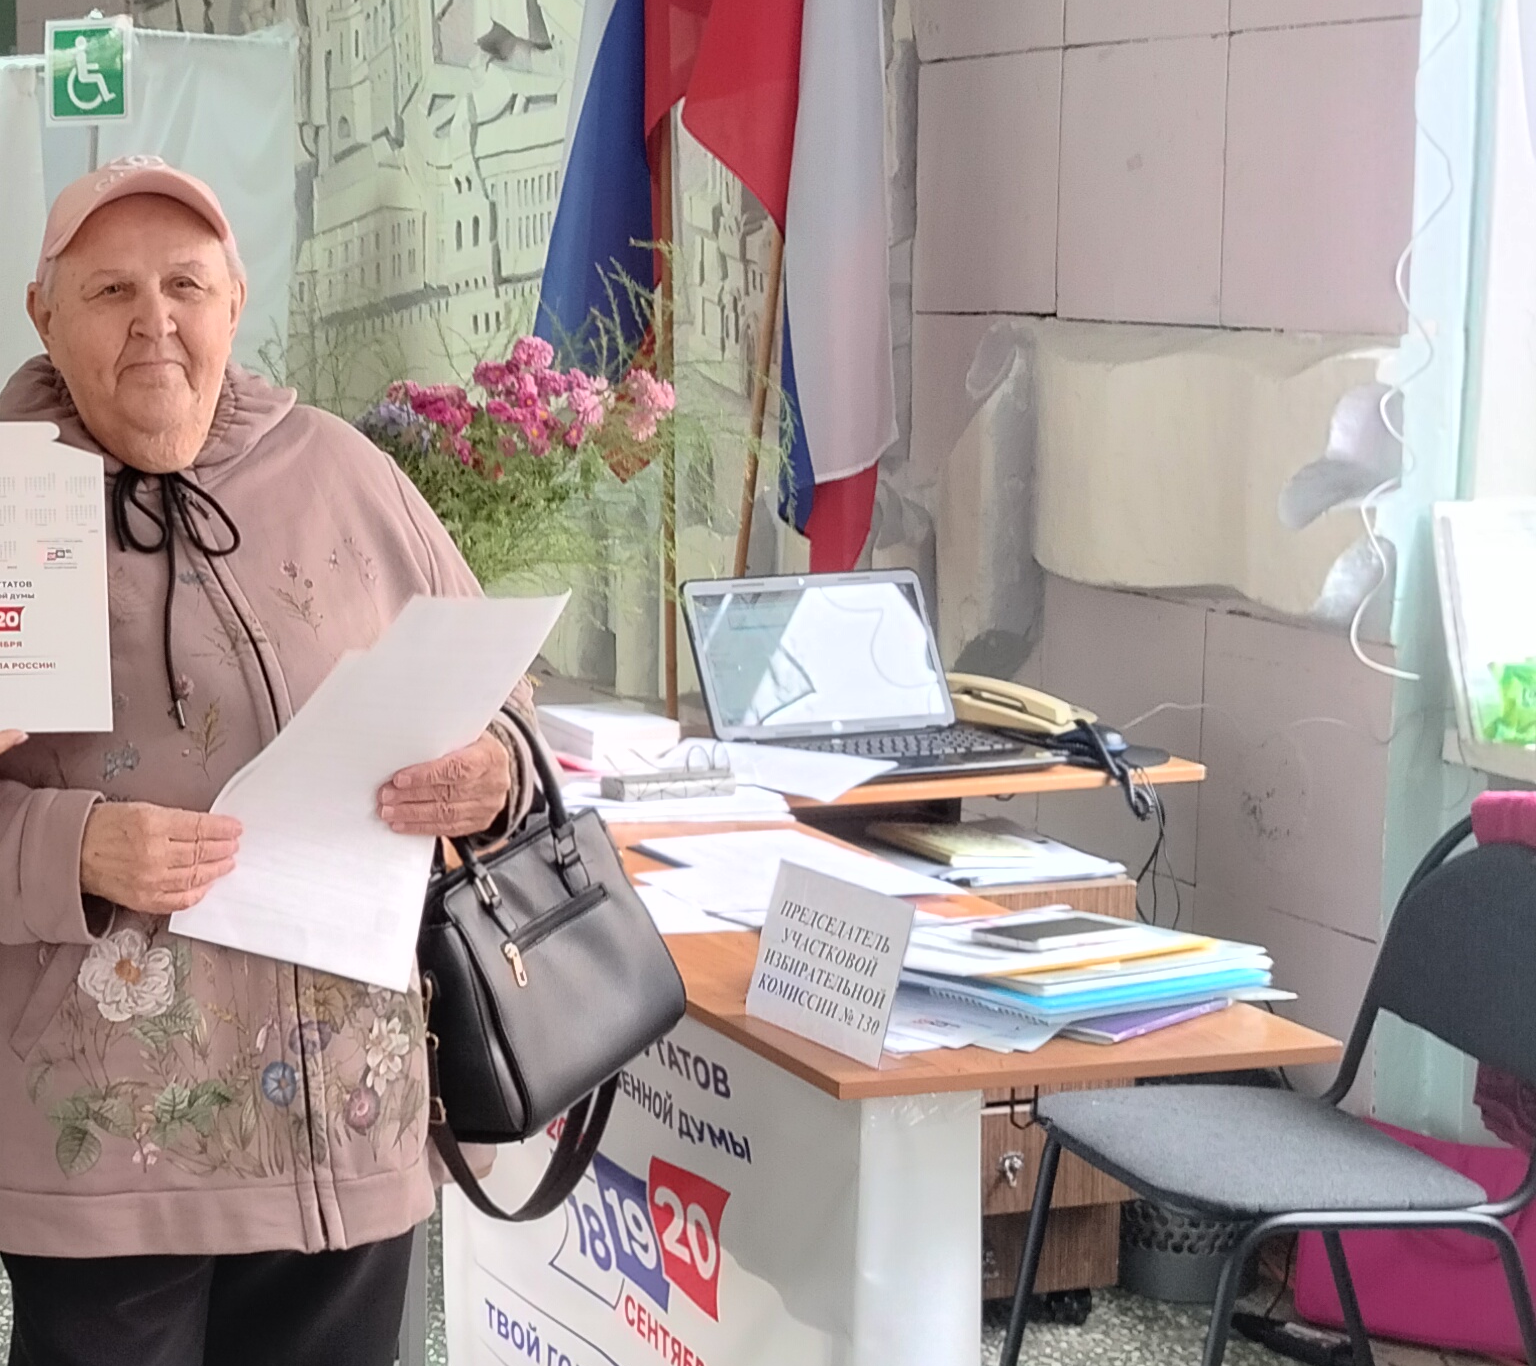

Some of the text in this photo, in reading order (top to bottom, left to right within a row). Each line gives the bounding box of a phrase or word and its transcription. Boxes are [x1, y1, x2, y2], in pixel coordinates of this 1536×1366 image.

[12, 662, 56, 670] РОССИИ!
[780, 900, 890, 954] ПРЕДСЕДАТЕЛЬ
[781, 927, 878, 978] УЧАСТКОВОЙ
[758, 973, 880, 1035] КОМИССИИ № 130
[764, 948, 886, 1010] ИЗБИРАТЕЛЬНОЙ
[645, 1035, 731, 1099] ТАТОВ
[617, 1068, 752, 1164] ЕННОЙ ДУМЫ
[568, 1186, 716, 1280] 18 19 20
[485, 1298, 541, 1364] ТВОЙ
